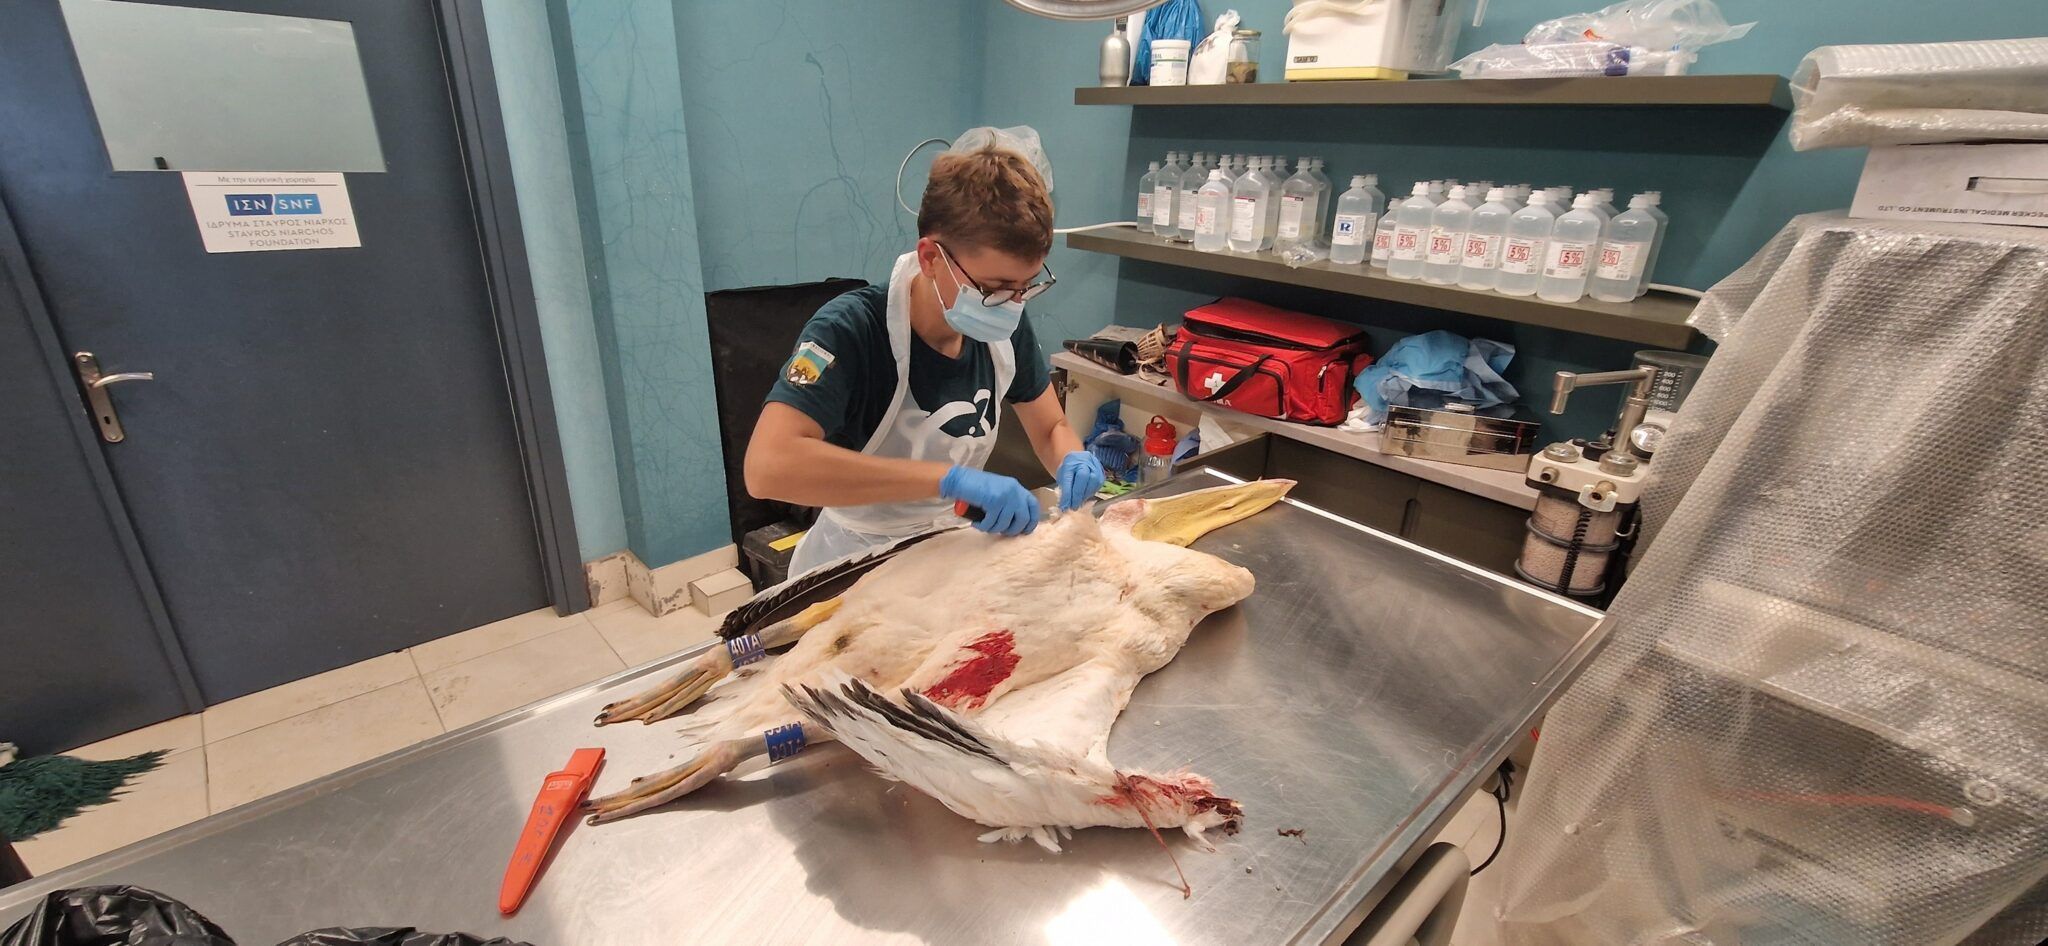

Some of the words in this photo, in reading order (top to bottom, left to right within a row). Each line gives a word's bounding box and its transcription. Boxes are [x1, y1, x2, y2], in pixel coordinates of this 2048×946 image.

[234, 199, 267, 211] ΙΣΝ
[279, 199, 313, 210] SNF
[1911, 206, 1968, 214] INSTRUMENT
[1969, 208, 2010, 216] MEDICAL
[206, 220, 250, 228] ΙΔΡΥΜΑ
[252, 219, 301, 228] ΣΤΑΥΡΟΣ
[304, 218, 348, 226] ΝΙΑΡΧΟΣ
[1340, 223, 1351, 231] R
[227, 230, 277, 238] STAVROS
[280, 228, 334, 236] NIARCHOS
[249, 238, 320, 247] FOUNDATION
[1400, 235, 1414, 247] 5%
[1434, 239, 1448, 250] 5%
[1468, 241, 1482, 253] 5%
[1510, 247, 1526, 259] 5%
[1563, 252, 1580, 264] 5%
